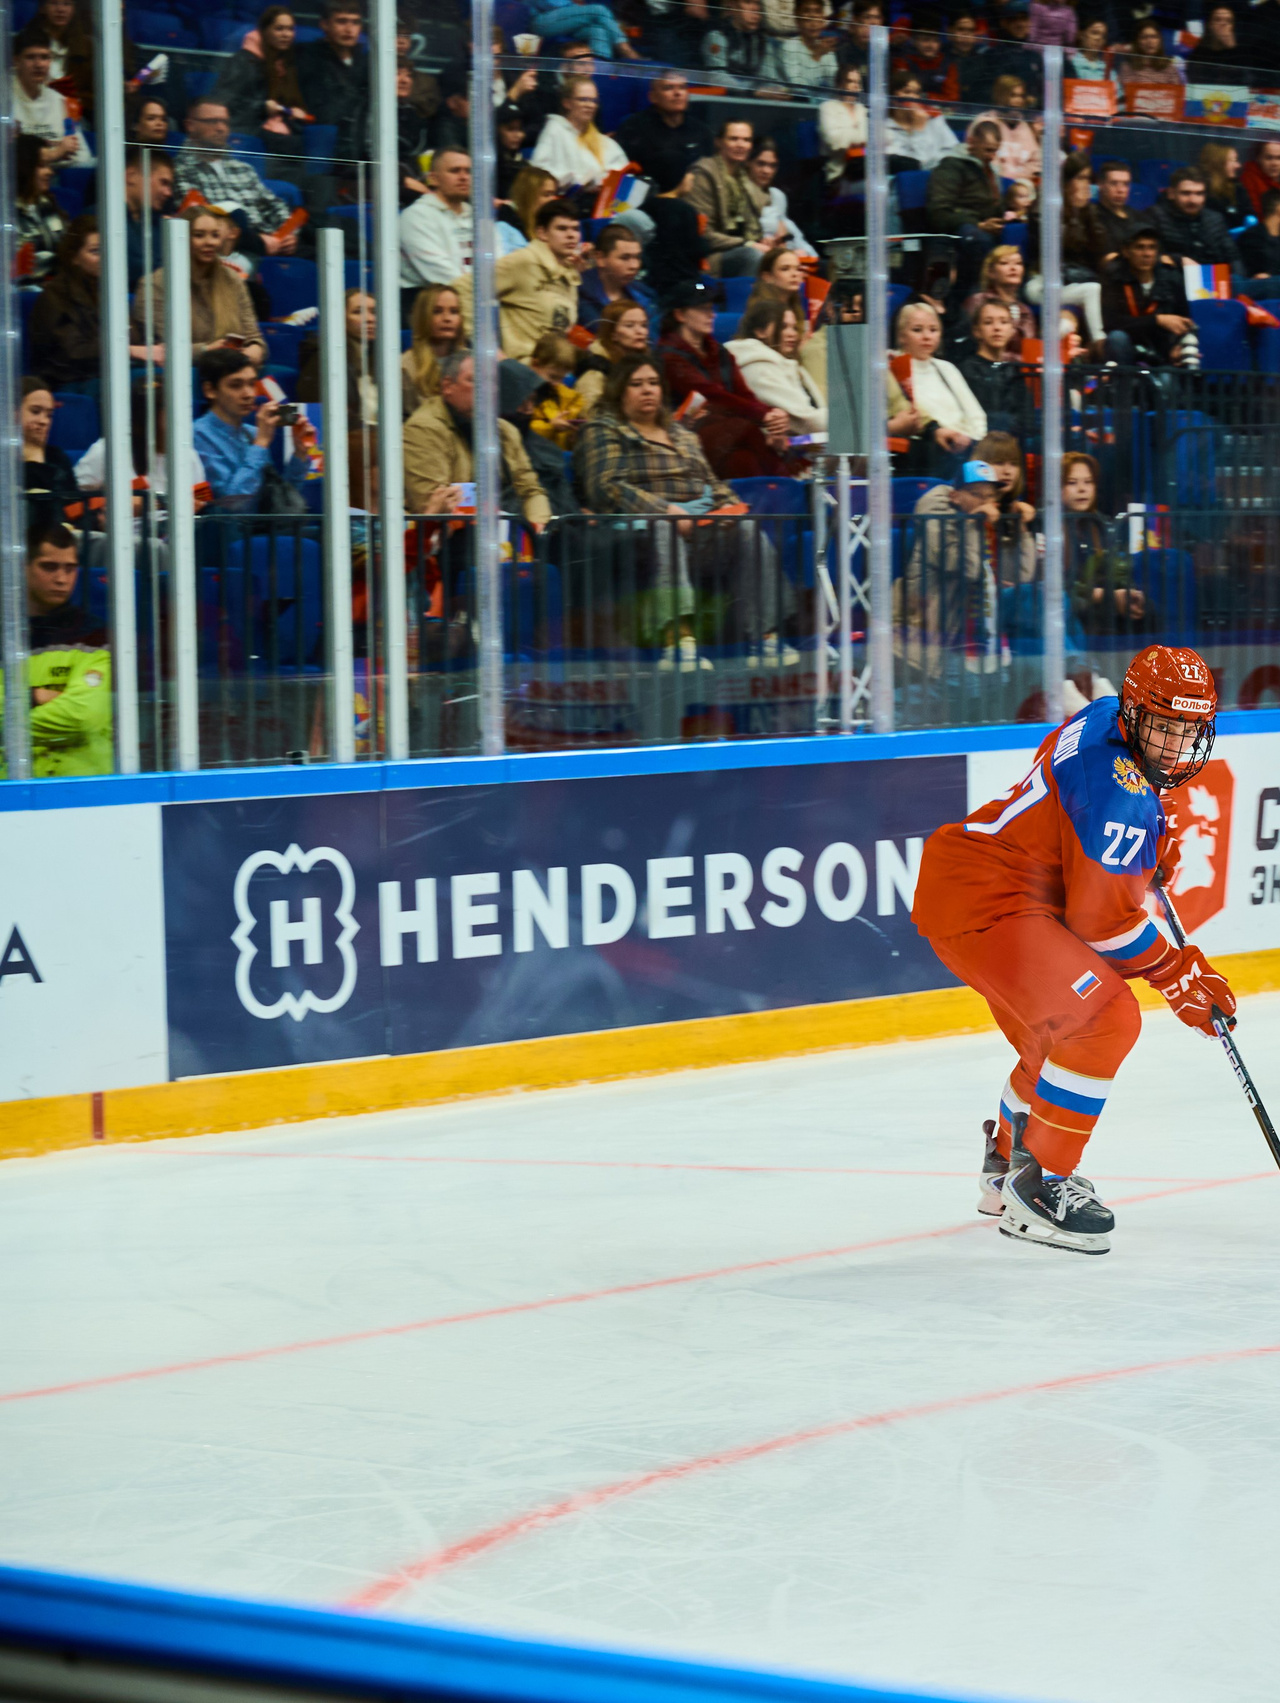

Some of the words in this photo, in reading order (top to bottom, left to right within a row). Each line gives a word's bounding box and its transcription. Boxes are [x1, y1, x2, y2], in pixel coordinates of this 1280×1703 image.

[1173, 699, 1210, 711] РОЛЬФ
[1102, 821, 1146, 867] 27
[378, 837, 924, 967] HENDERSON
[270, 897, 323, 968] H
